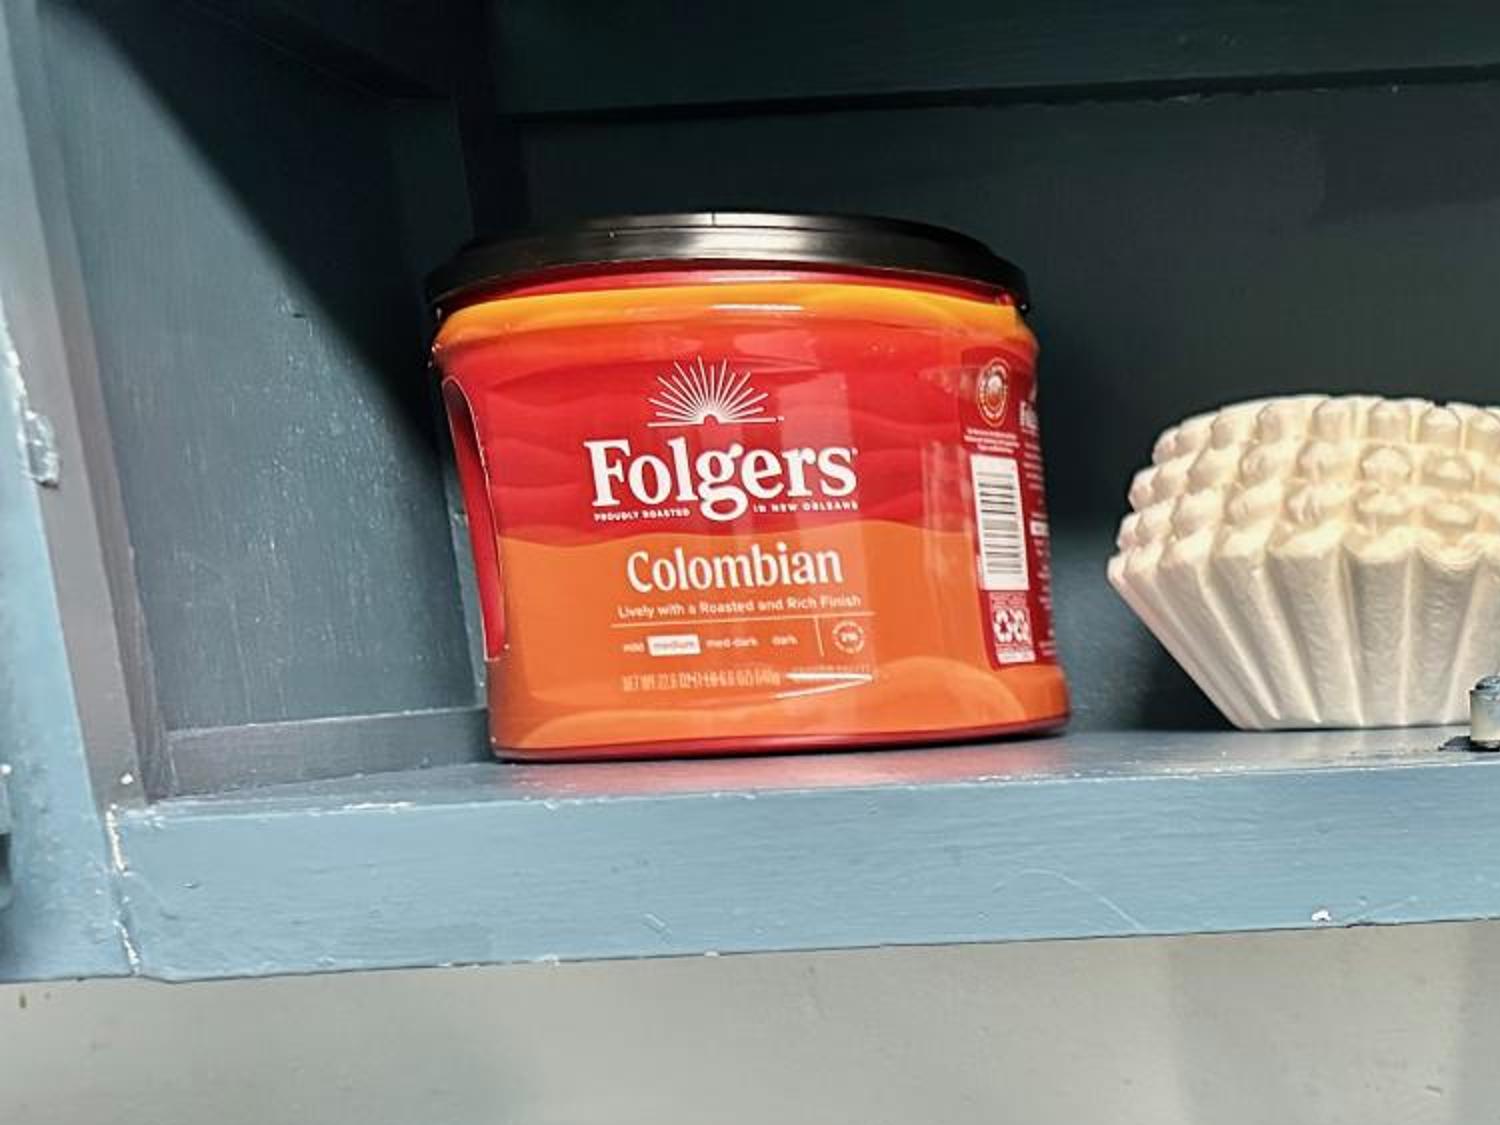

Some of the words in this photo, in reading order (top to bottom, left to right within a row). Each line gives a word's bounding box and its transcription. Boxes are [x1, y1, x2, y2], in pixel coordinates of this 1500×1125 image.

[584, 436, 858, 521] Folgers
[627, 541, 844, 593] Colombian
[618, 604, 654, 620] Lively
[657, 604, 685, 616] with
[688, 606, 697, 615] a
[699, 600, 755, 614] Roasted
[758, 600, 784, 612] and
[787, 597, 818, 610] Rich
[820, 594, 862, 609] Finish
